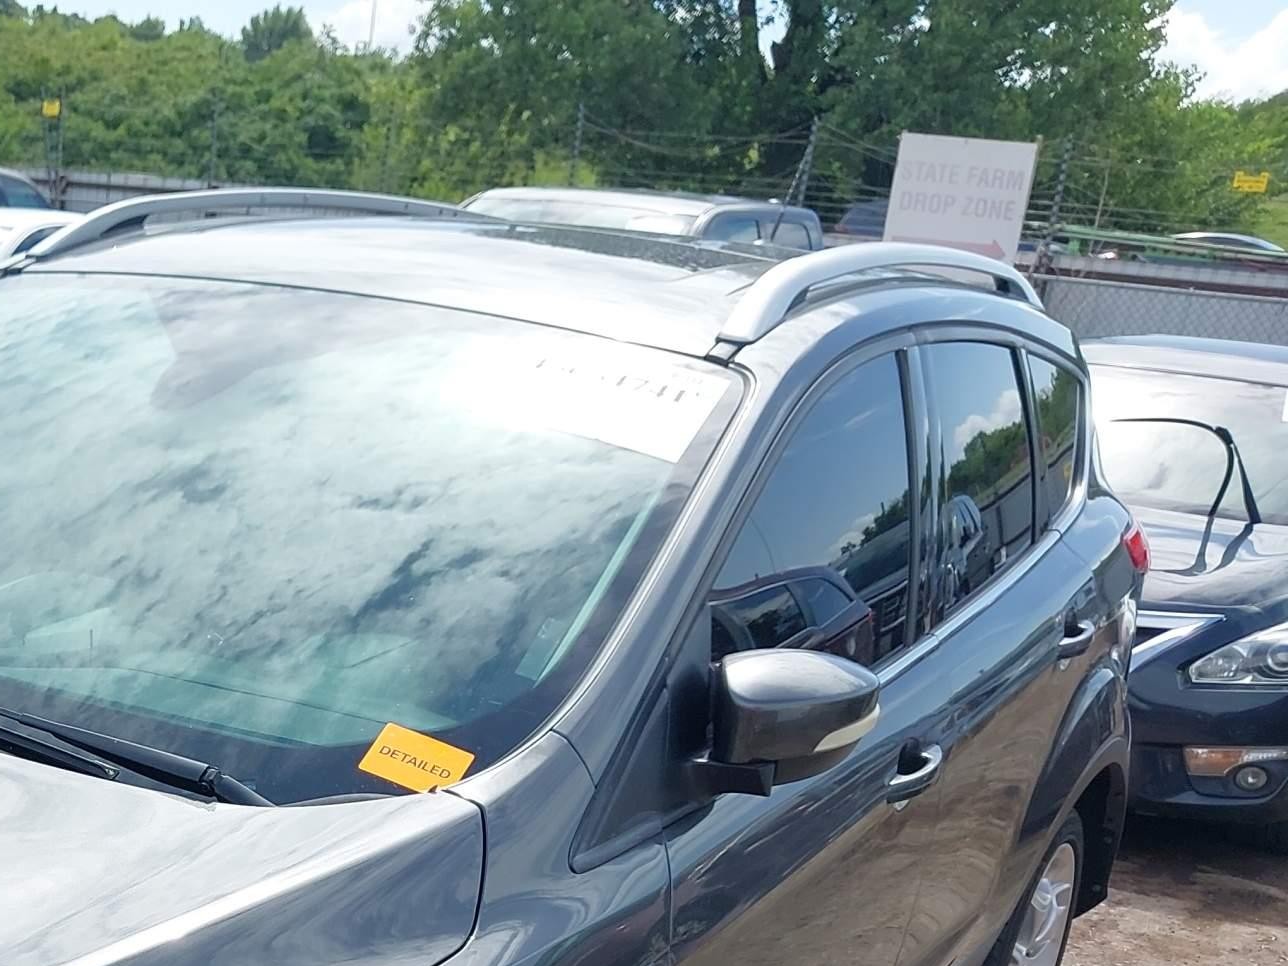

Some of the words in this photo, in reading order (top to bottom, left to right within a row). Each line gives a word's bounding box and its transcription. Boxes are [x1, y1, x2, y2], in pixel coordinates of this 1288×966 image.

[901, 160, 960, 184] STATE
[966, 165, 1025, 191] FARM
[899, 191, 956, 216] DROP
[961, 195, 1016, 221] ZONE
[379, 745, 451, 779] DETAILED
